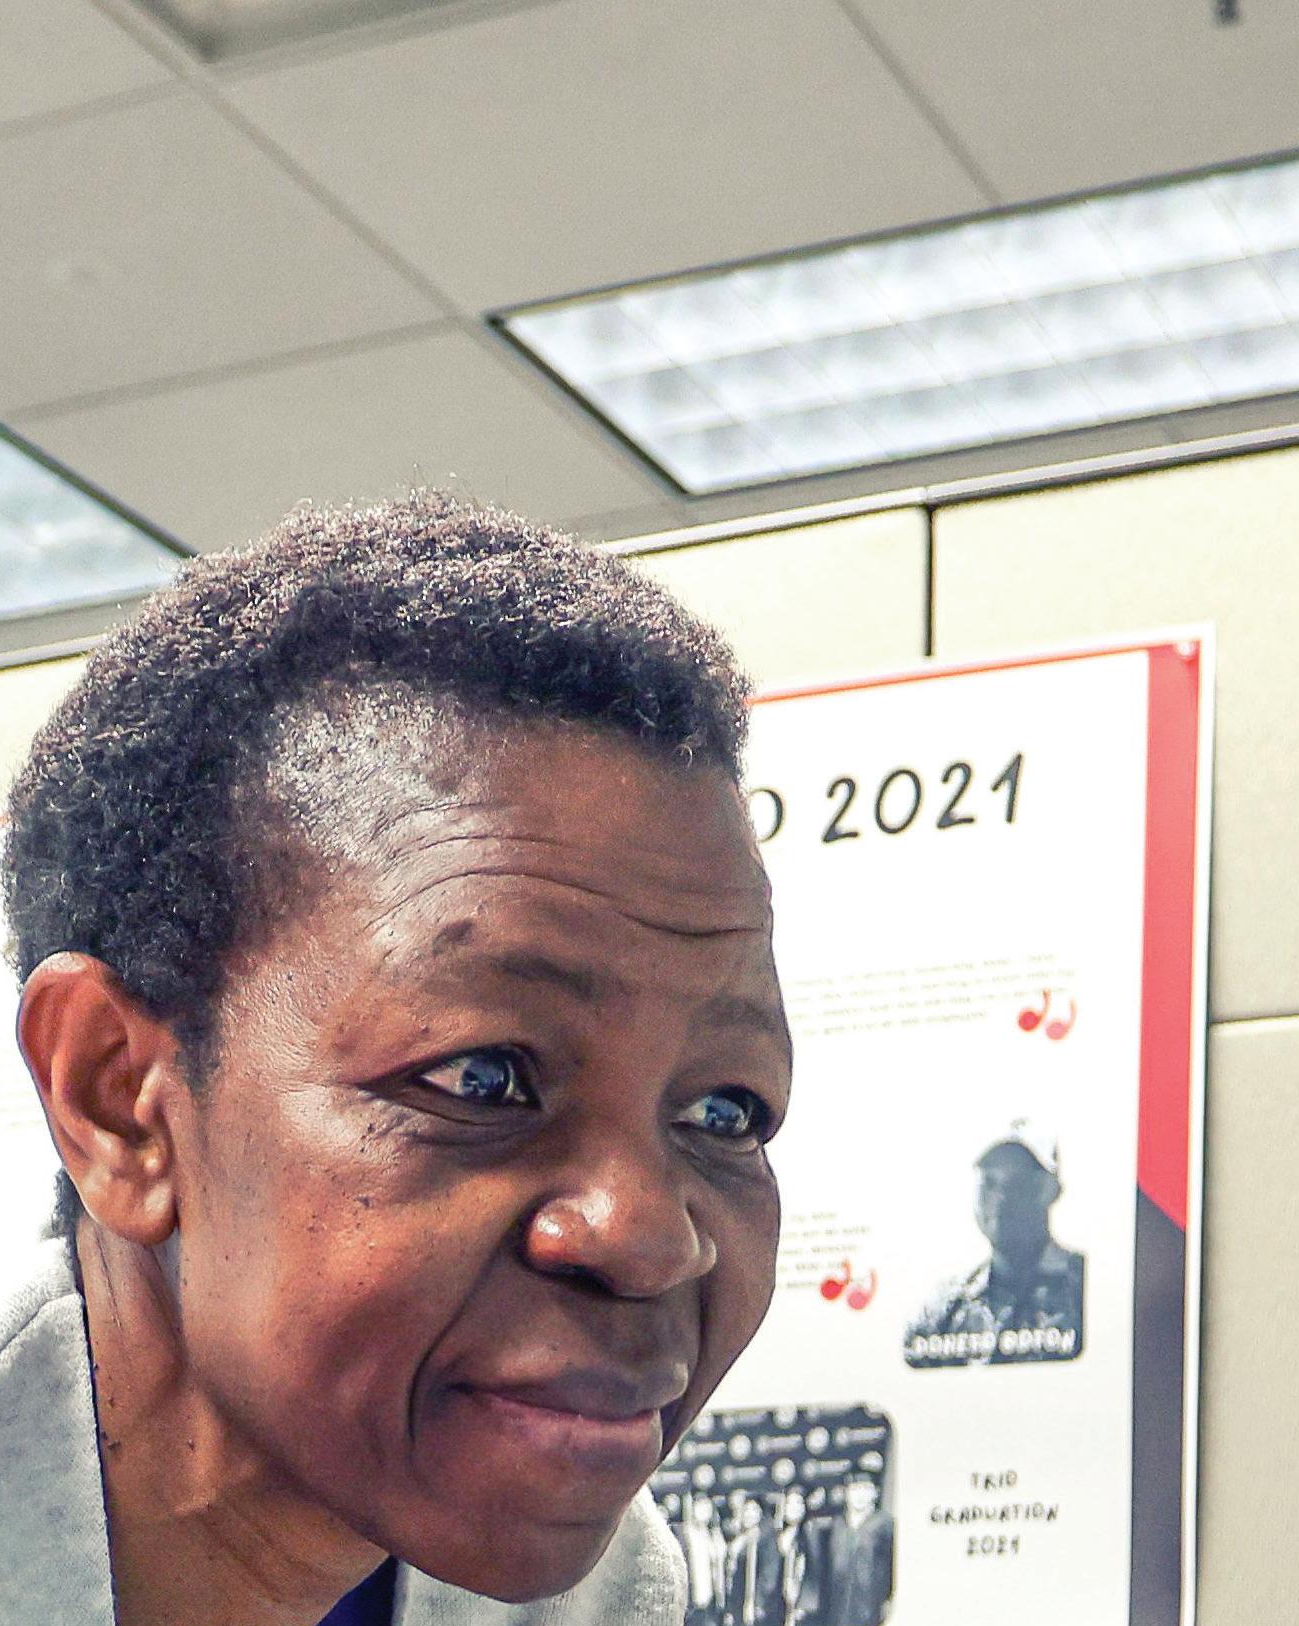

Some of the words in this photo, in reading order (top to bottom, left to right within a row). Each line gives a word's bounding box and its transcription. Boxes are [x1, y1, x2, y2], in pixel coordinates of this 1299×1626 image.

[821, 752, 1025, 845] 2021
[970, 1470, 1019, 1490] TRIO
[929, 1501, 1060, 1525] GRADUATION
